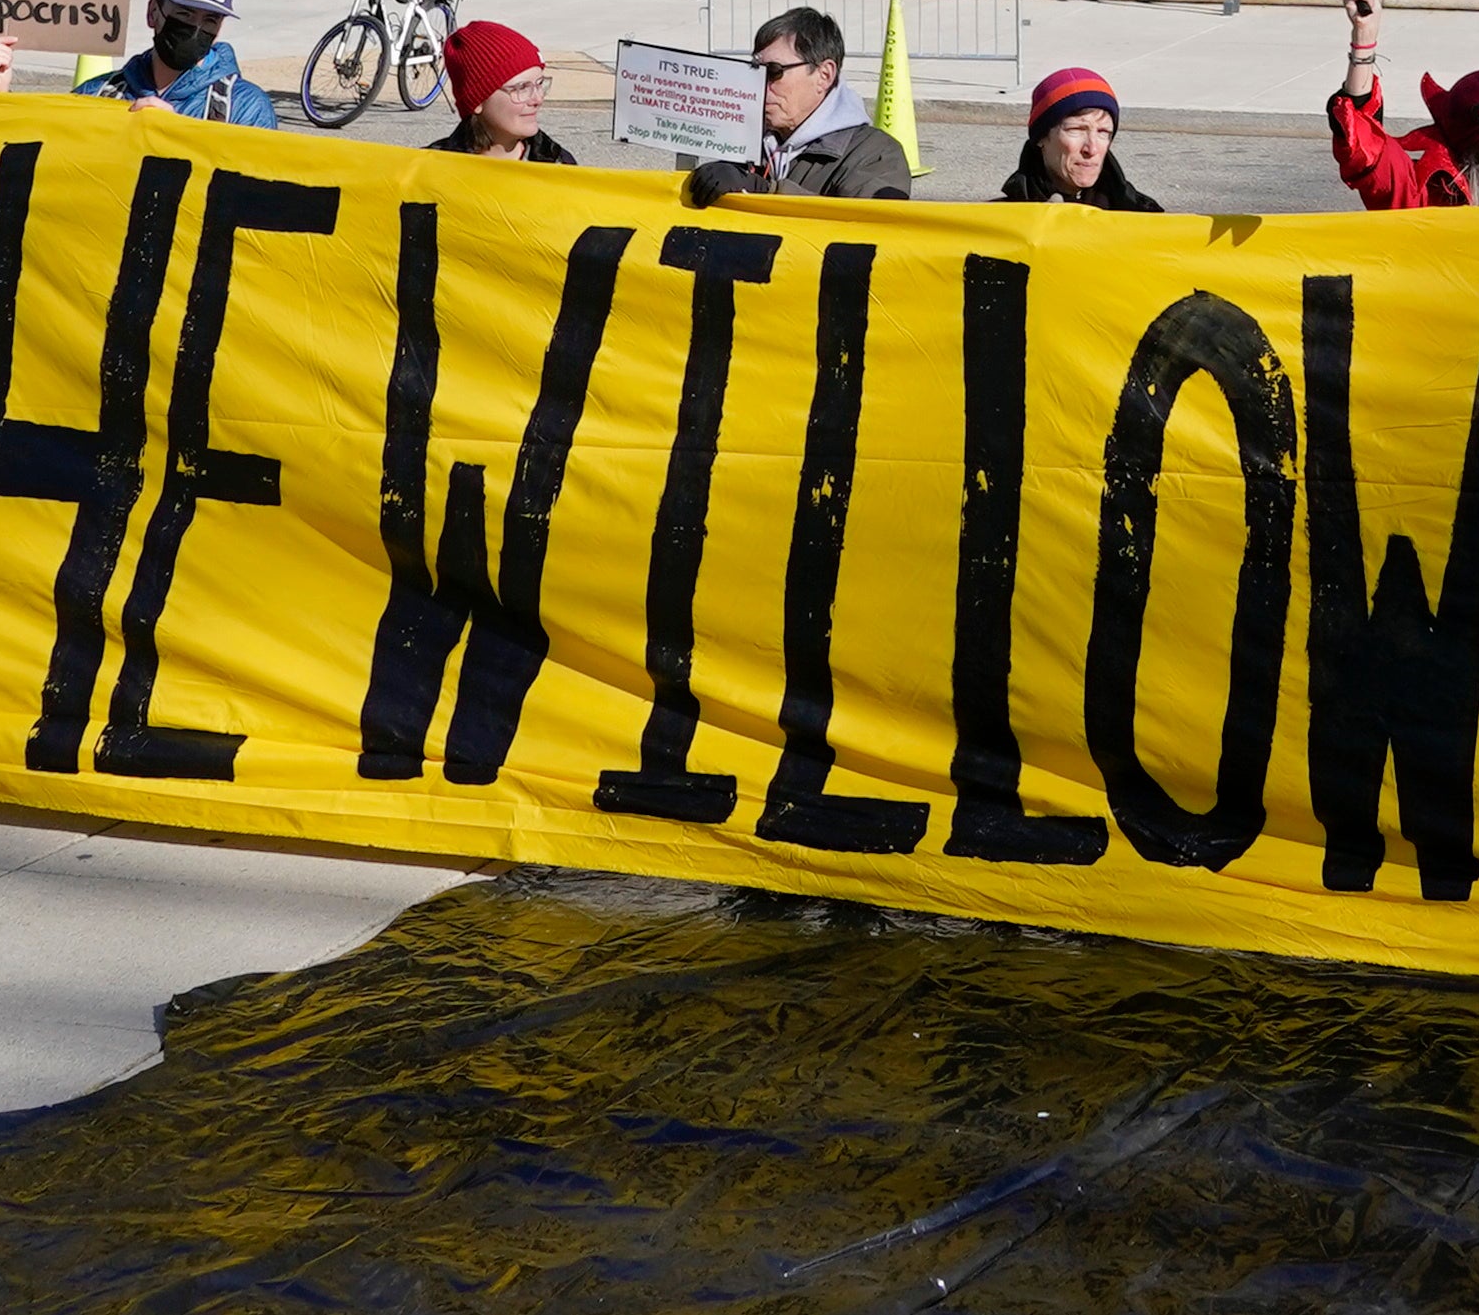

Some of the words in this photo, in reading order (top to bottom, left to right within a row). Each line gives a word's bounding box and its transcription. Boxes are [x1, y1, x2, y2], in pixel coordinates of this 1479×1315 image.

[886, 30, 896, 53] DOI
[658, 60, 680, 74] IT'S
[683, 64, 719, 80] TRUE:
[621, 69, 638, 81] Our
[639, 73, 652, 83] oil
[653, 77, 692, 91] reserves
[695, 84, 710, 94] are
[712, 85, 758, 101] sufficient
[633, 84, 654, 95] New
[655, 88, 687, 103] drilling
[689, 95, 742, 111] guarantees
[883, 63, 895, 128] SECURITY
[629, 94, 671, 110] CLIMATE
[672, 102, 746, 124] CATASTROPHE
[627, 124, 650, 139] Stop
[651, 129, 668, 141] the
[670, 133, 703, 148] Willow
[705, 138, 747, 155] Project!
[655, 117, 678, 129] Take
[680, 122, 716, 138] Action:
